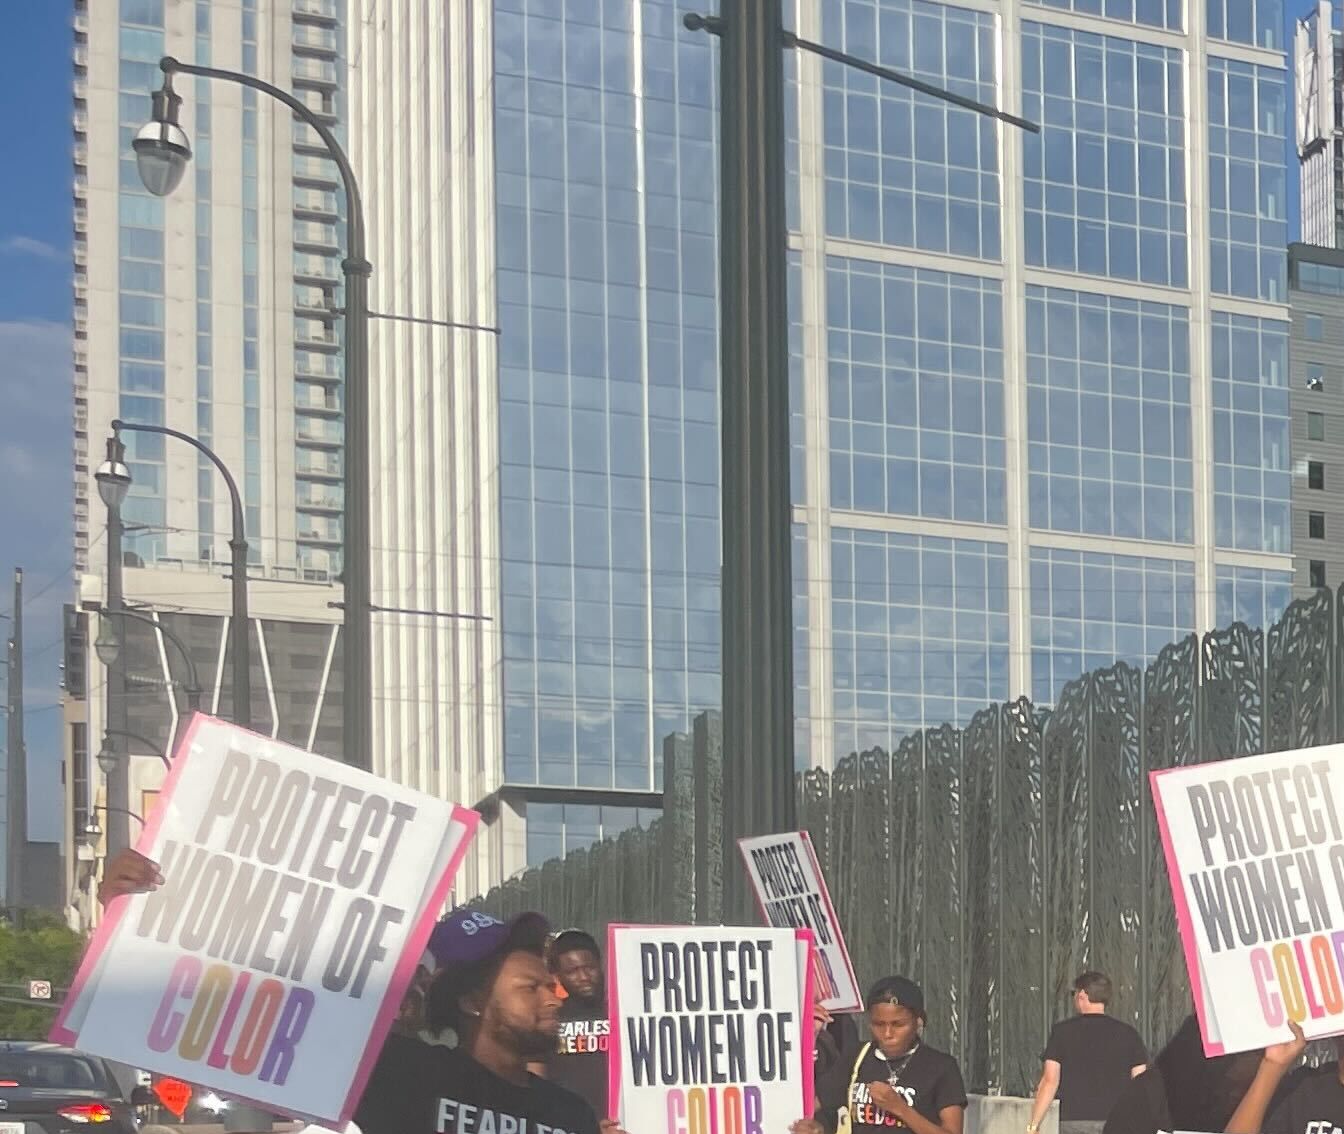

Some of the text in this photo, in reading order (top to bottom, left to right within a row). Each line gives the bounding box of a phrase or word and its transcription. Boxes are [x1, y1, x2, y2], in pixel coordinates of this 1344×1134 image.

[194, 749, 418, 898] PROTECT
[1186, 760, 1344, 867] PROTECT
[136, 839, 405, 999] WOMEN OF
[1189, 850, 1333, 954] WOMEN
[147, 954, 316, 1087] COLOR
[558, 1018, 610, 1037] EARLES
[640, 939, 774, 1014] PROTECT
[627, 1012, 793, 1087] WOMEN OF
